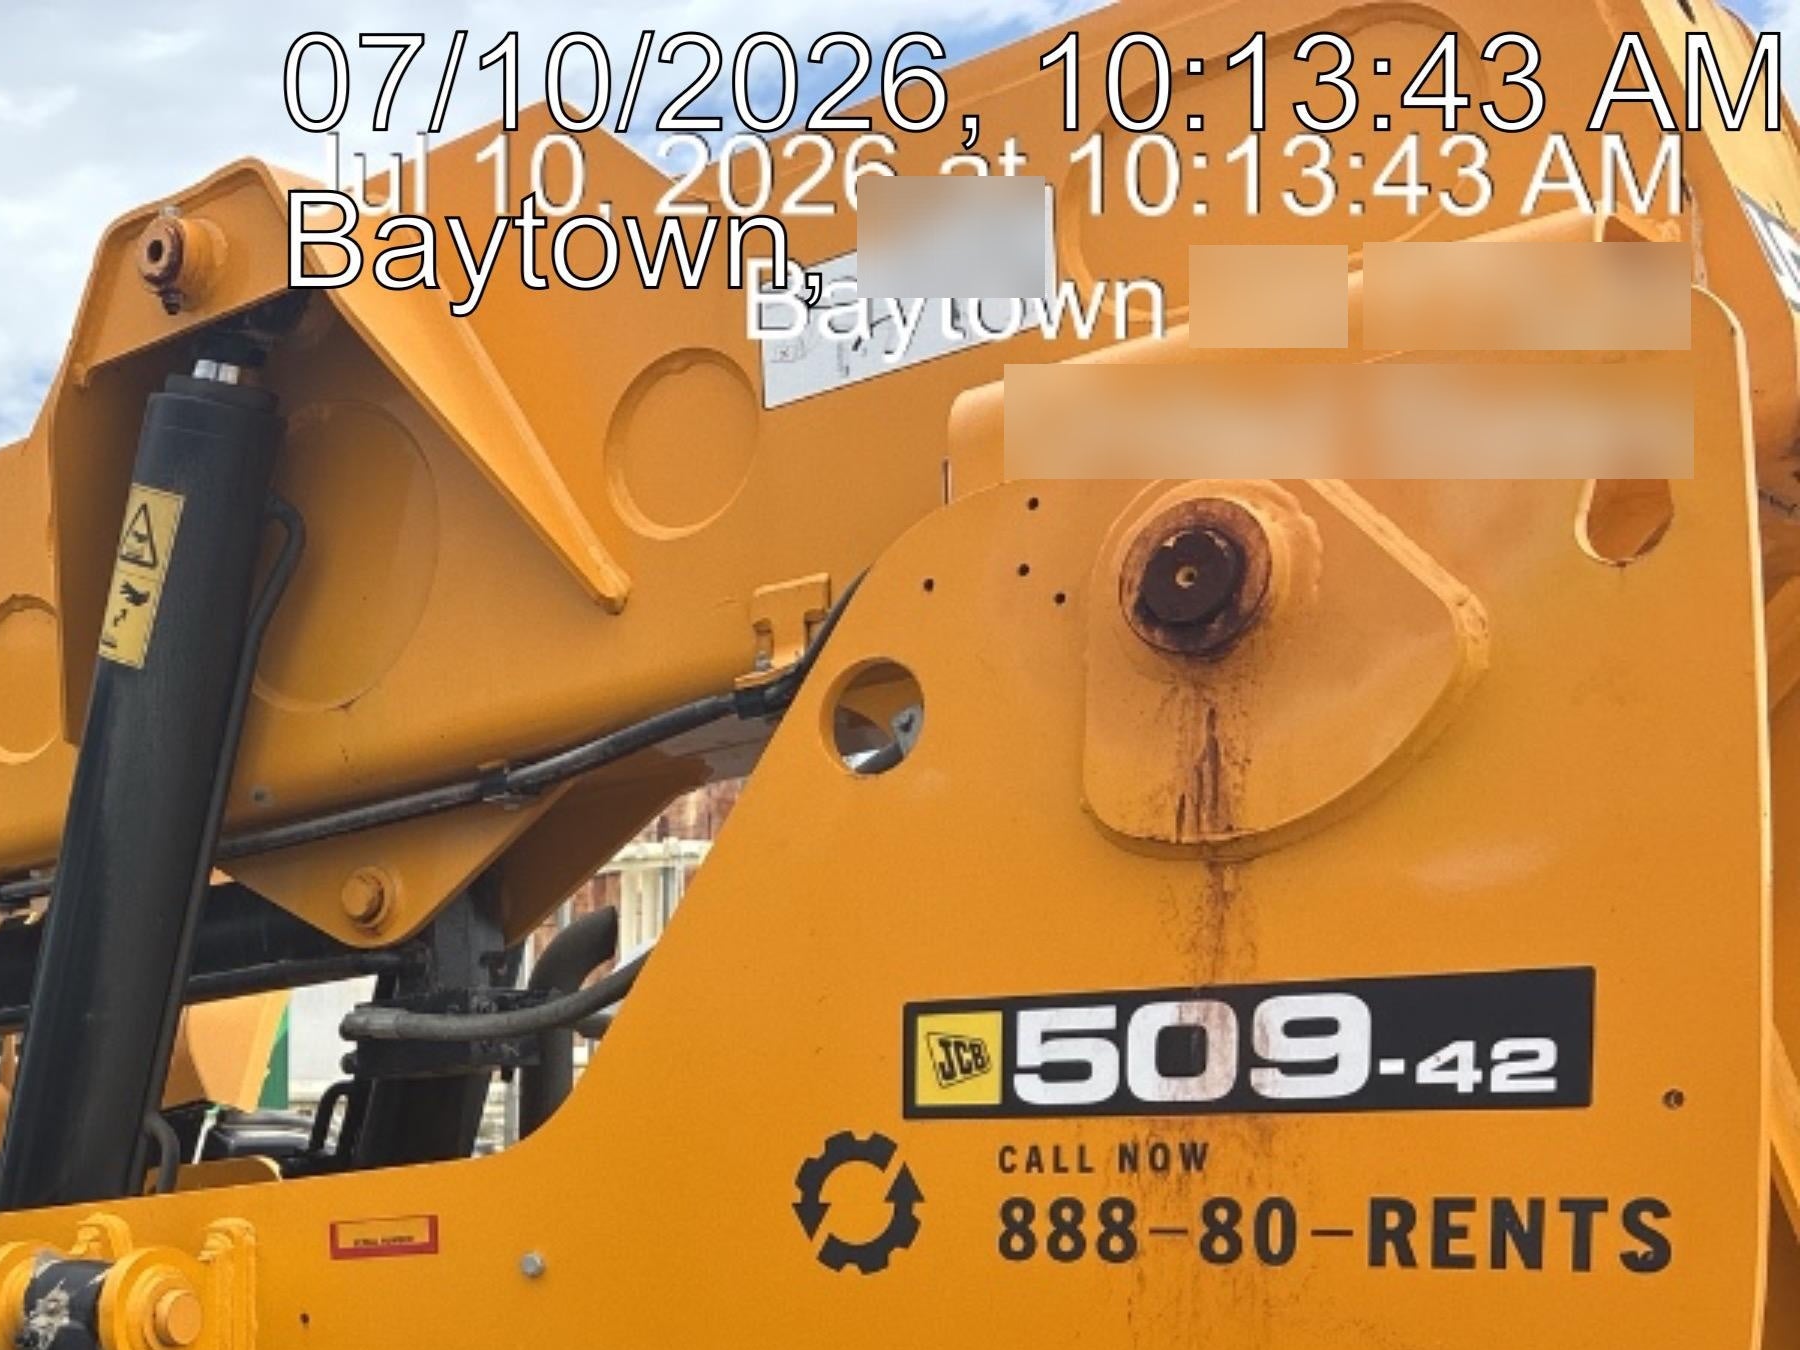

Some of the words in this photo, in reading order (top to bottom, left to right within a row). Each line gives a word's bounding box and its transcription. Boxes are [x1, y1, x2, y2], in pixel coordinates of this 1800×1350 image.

[937, 1037, 986, 1081] JCB
[1013, 992, 1559, 1105] 509-42
[998, 1144, 1094, 1174] CALL
[1118, 1142, 1210, 1174] NOW
